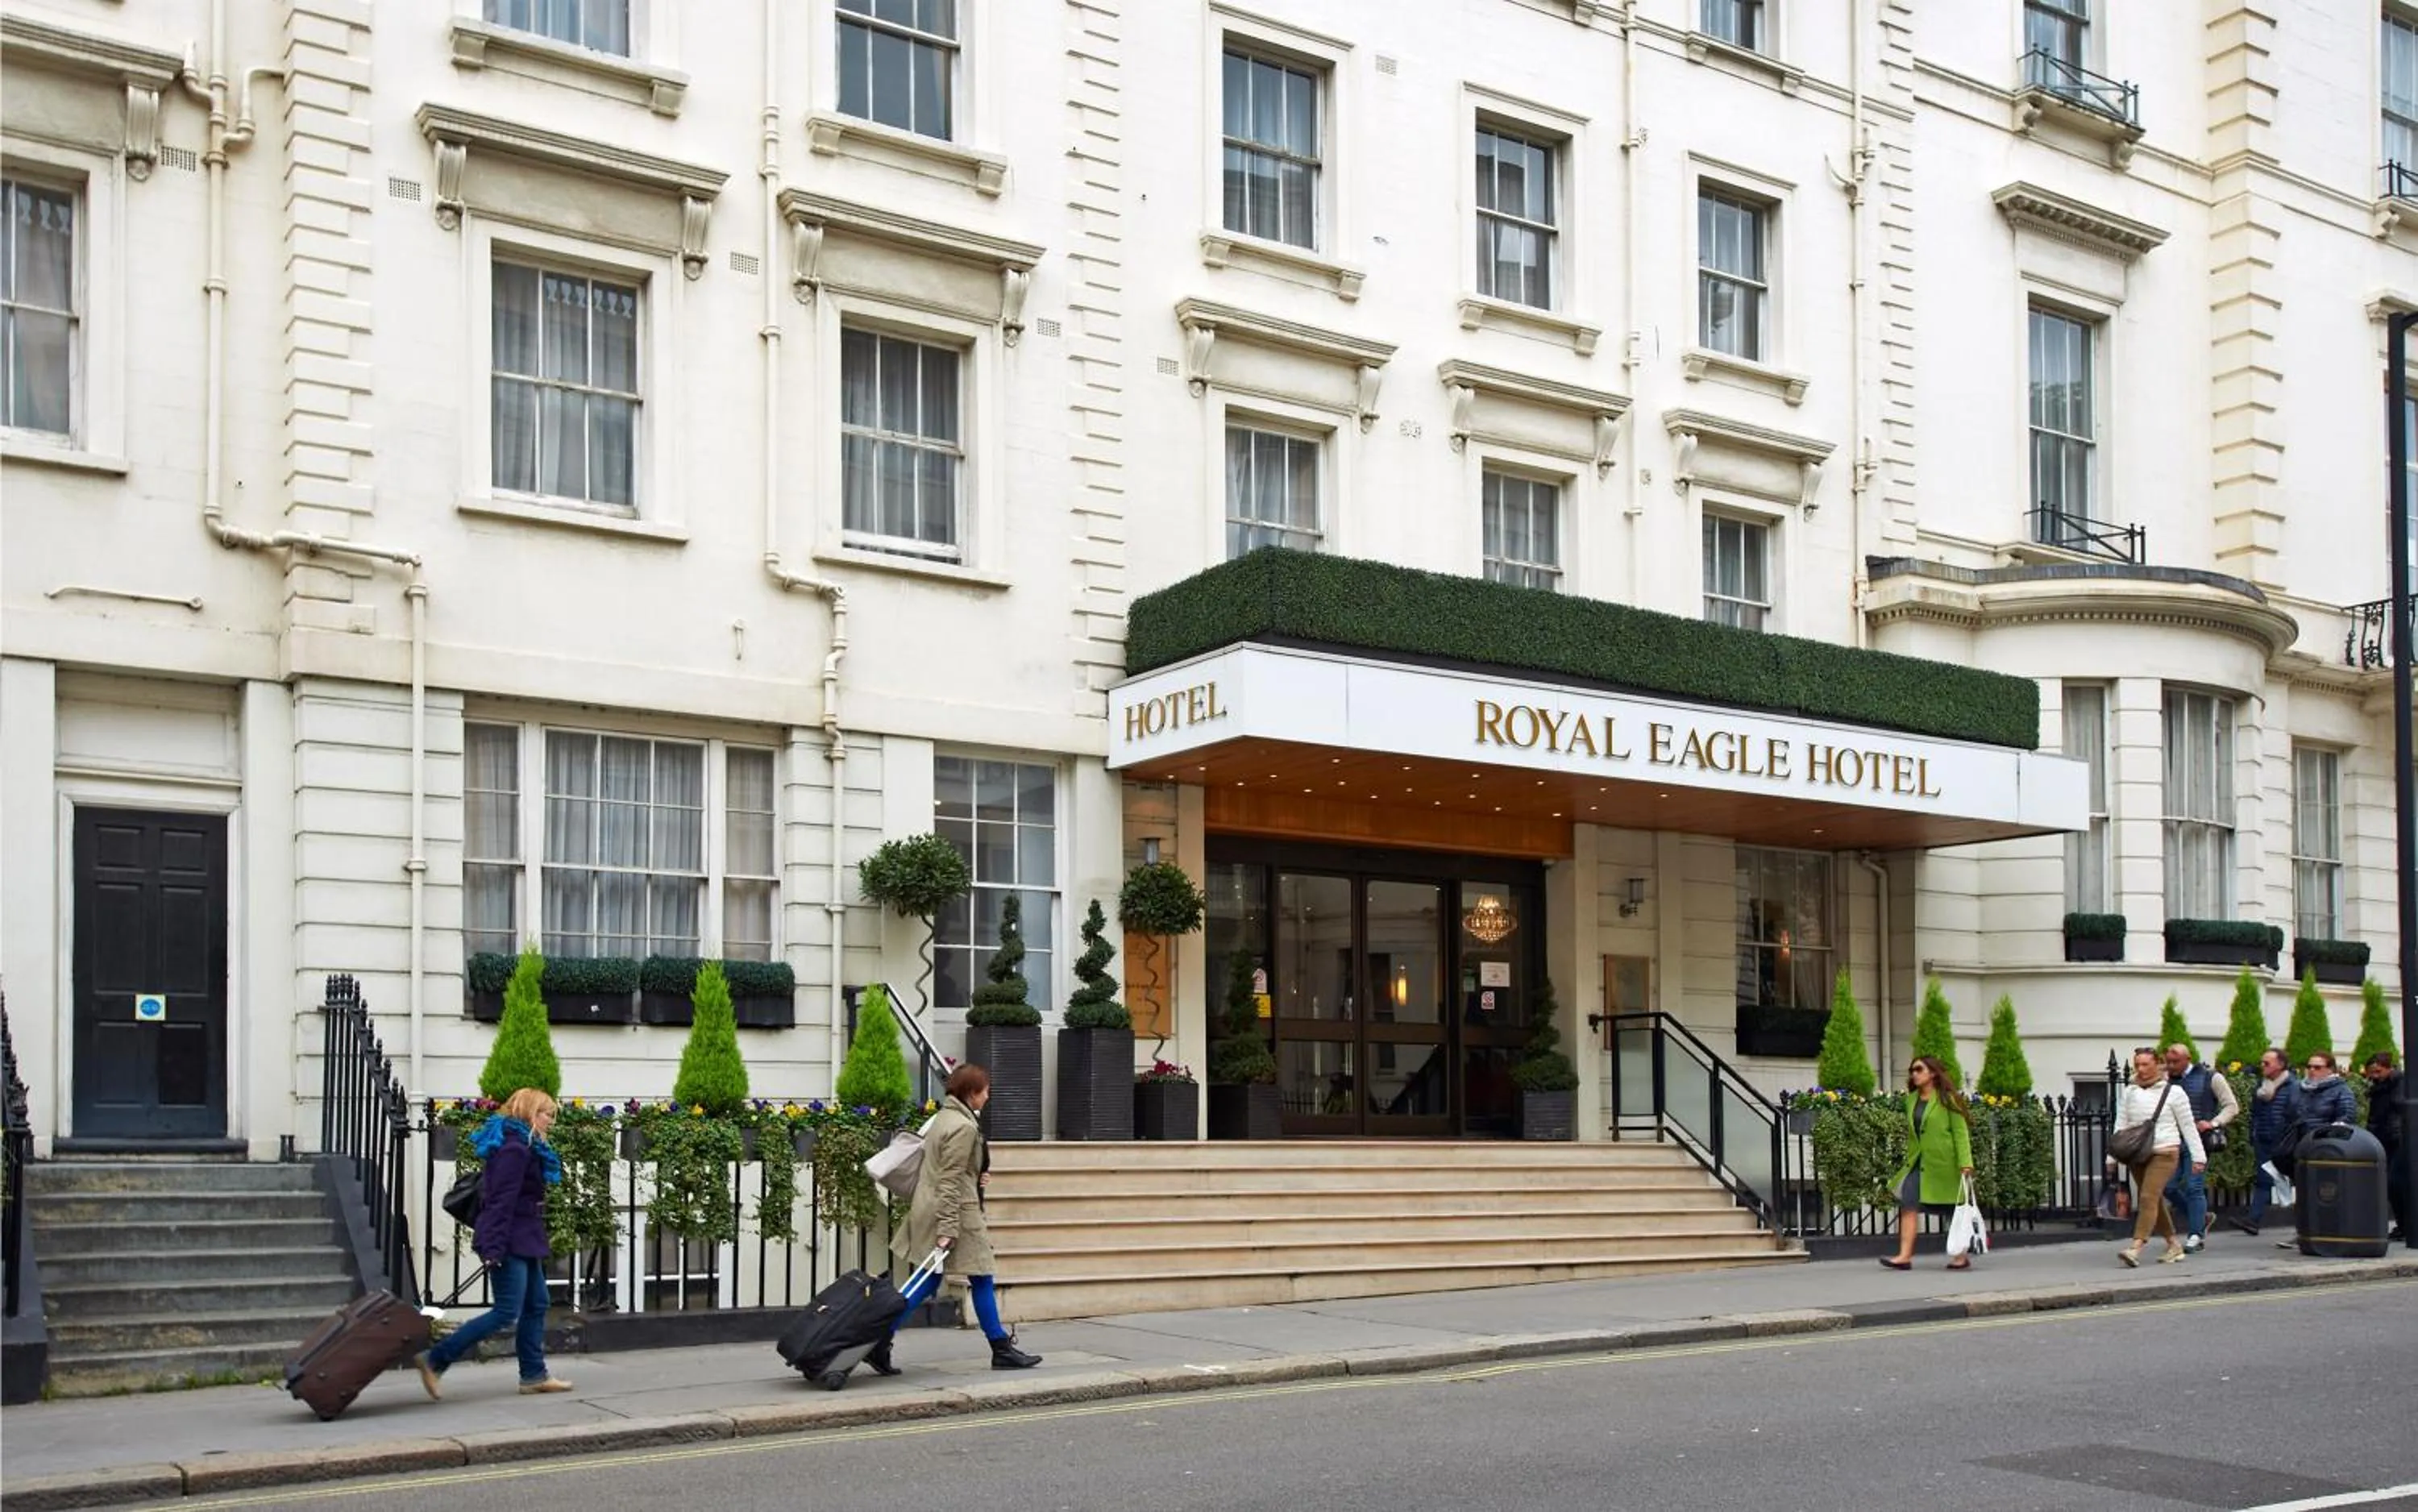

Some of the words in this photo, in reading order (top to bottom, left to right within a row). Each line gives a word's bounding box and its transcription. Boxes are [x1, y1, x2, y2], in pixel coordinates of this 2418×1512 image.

[1125, 682, 1228, 742] HOTEL
[1476, 700, 1631, 761] ROYAL
[1648, 722, 1792, 780] EAGLE
[1806, 743, 1942, 799] HOTEL
